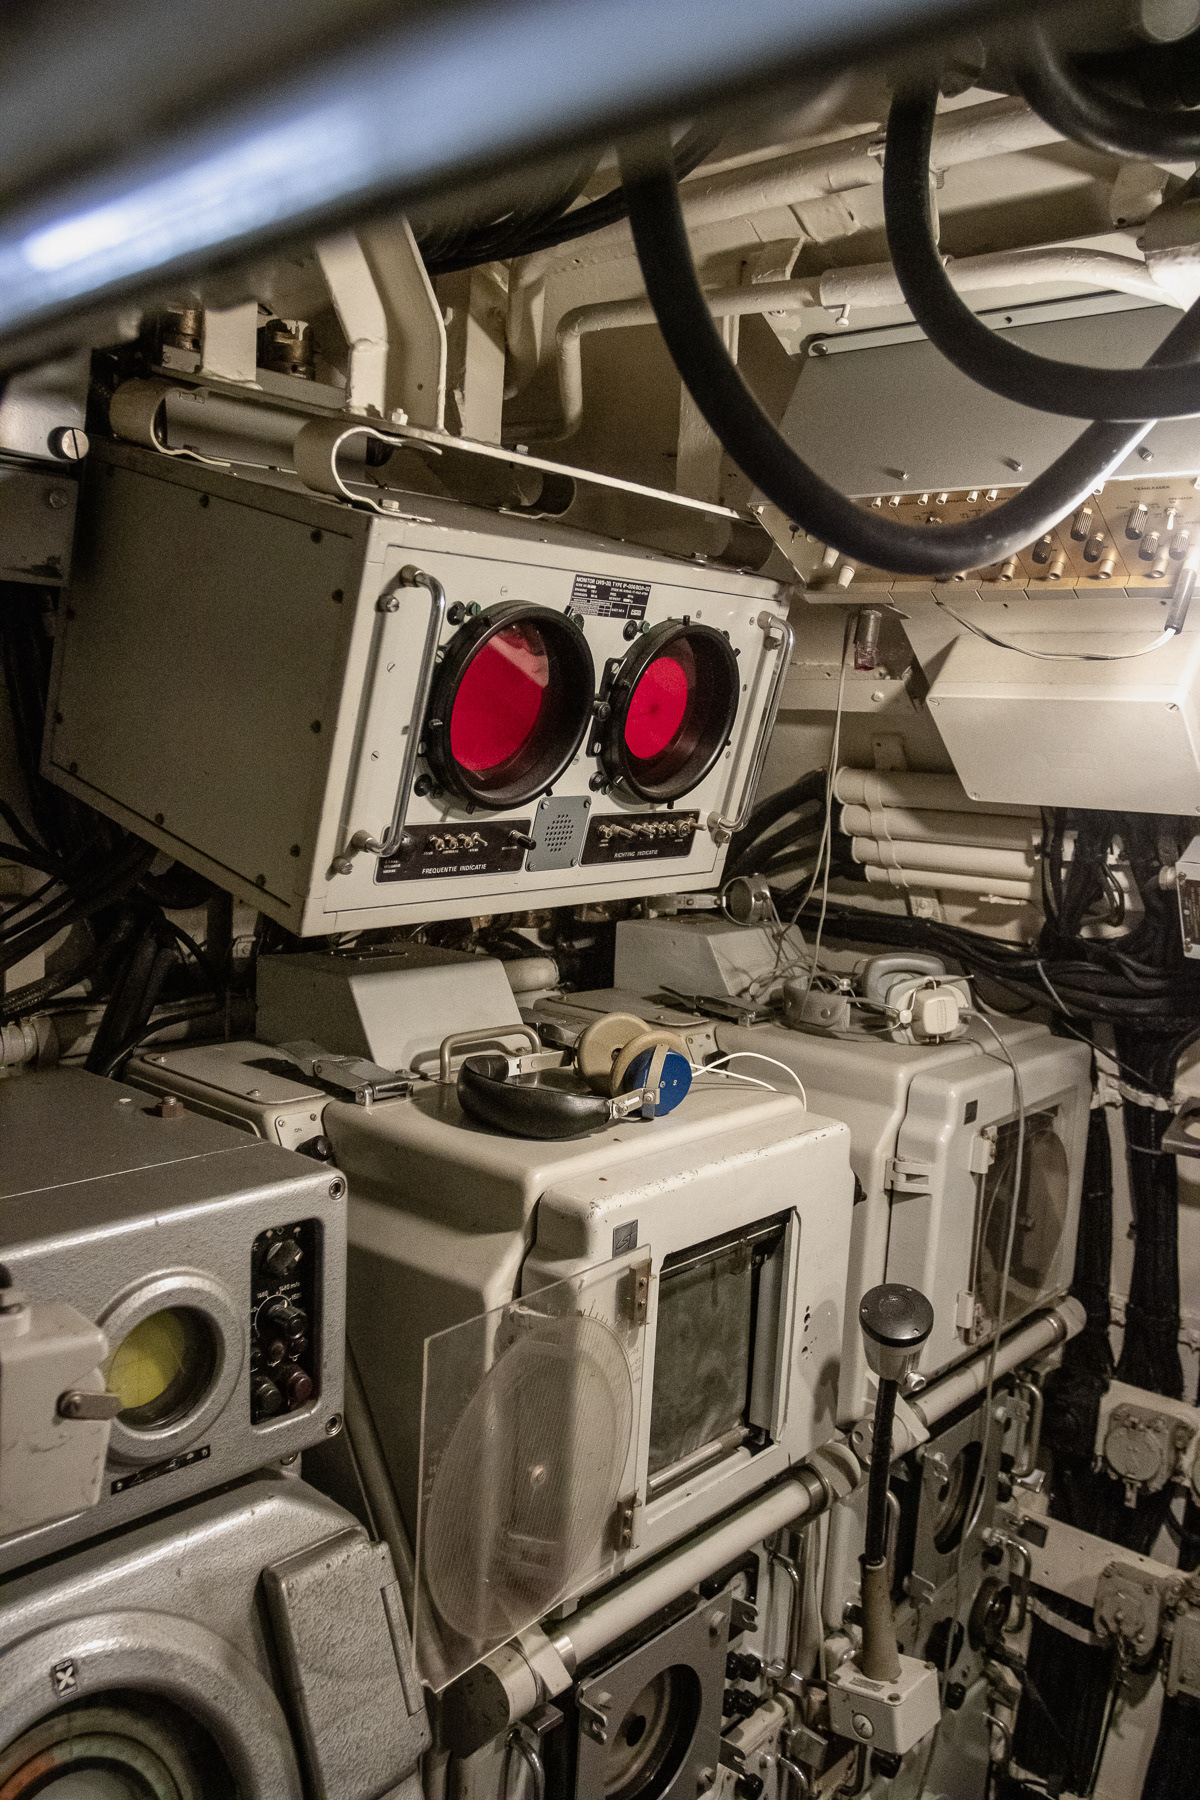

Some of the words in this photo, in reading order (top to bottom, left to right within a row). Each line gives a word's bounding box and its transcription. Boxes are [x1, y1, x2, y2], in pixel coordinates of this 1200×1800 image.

[576, 576, 596, 584] MONITOR
[636, 849, 659, 857] INDICATIE
[421, 865, 458, 875] FREQUENTIE
[459, 863, 487, 872] INDICATIE
